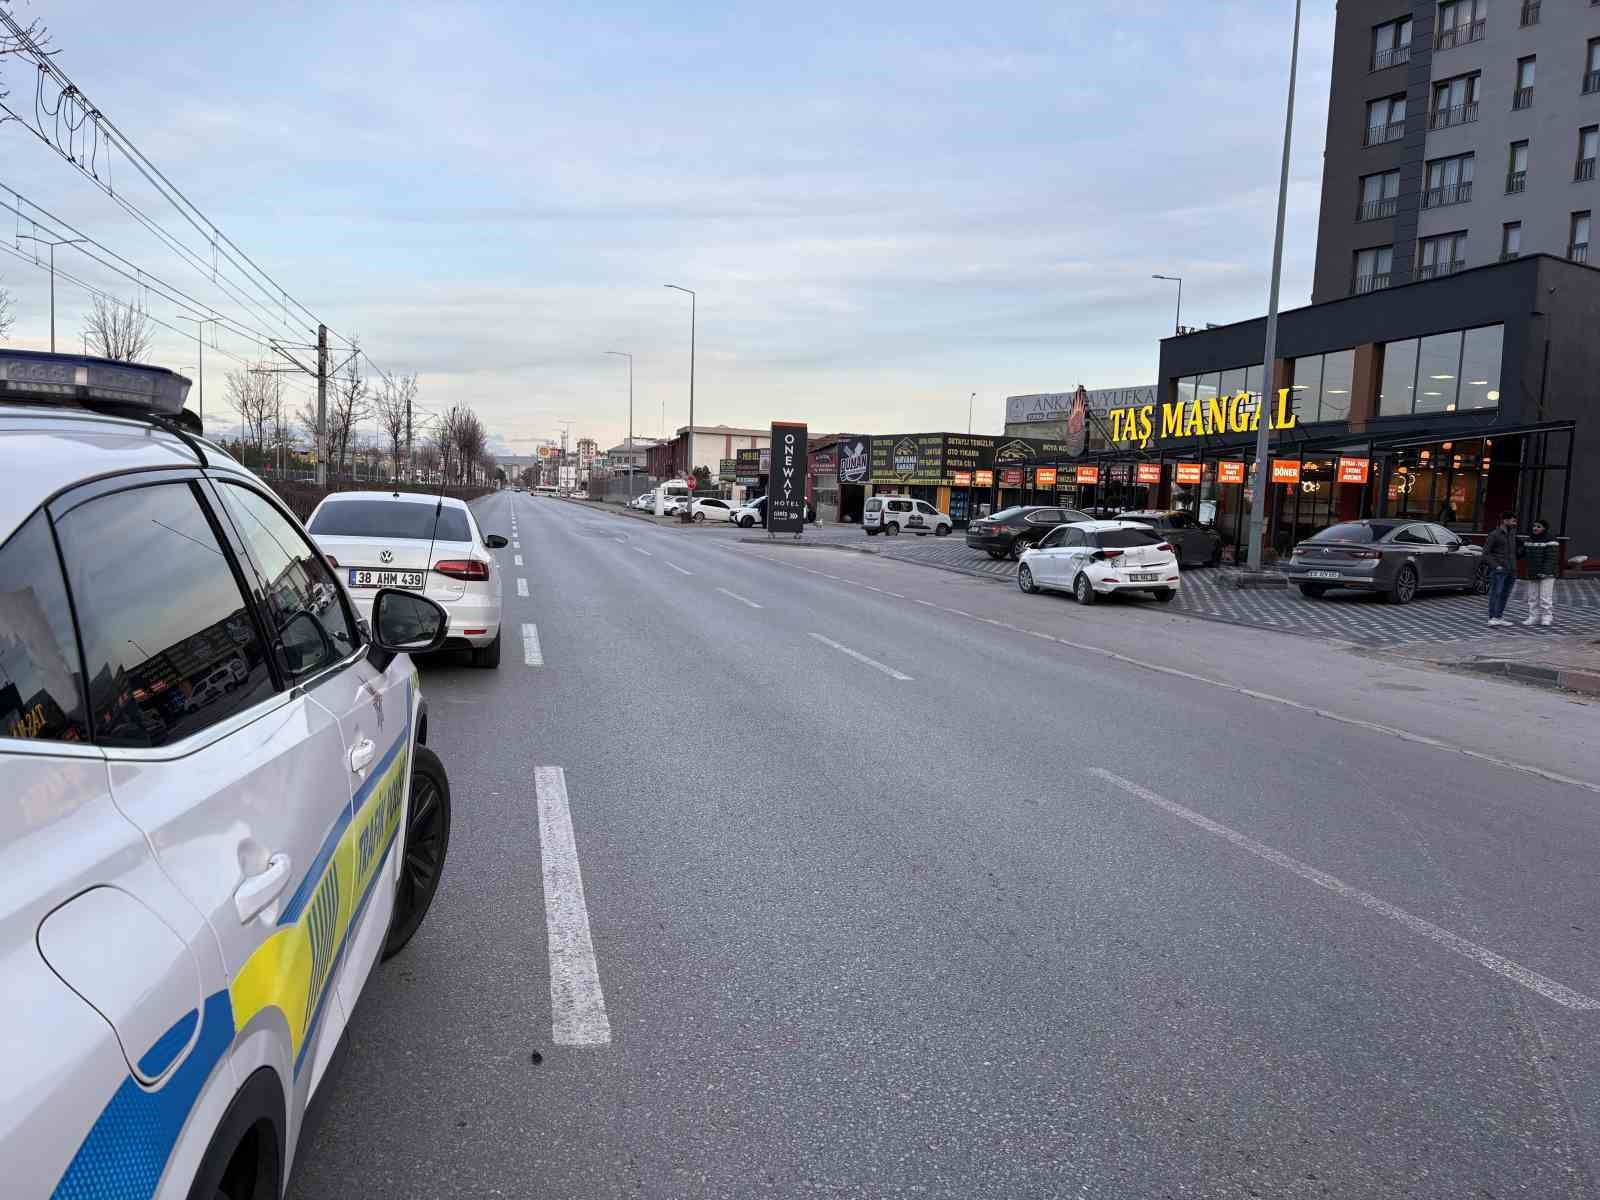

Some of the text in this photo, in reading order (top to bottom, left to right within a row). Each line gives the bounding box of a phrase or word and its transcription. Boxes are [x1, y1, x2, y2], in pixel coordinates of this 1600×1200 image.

[1032, 392, 1096, 411] ANKAA
[1110, 406, 1153, 449] TAŞ
[1274, 465, 1297, 476] DÖNER
[359, 572, 420, 585] 38 AHM 439
